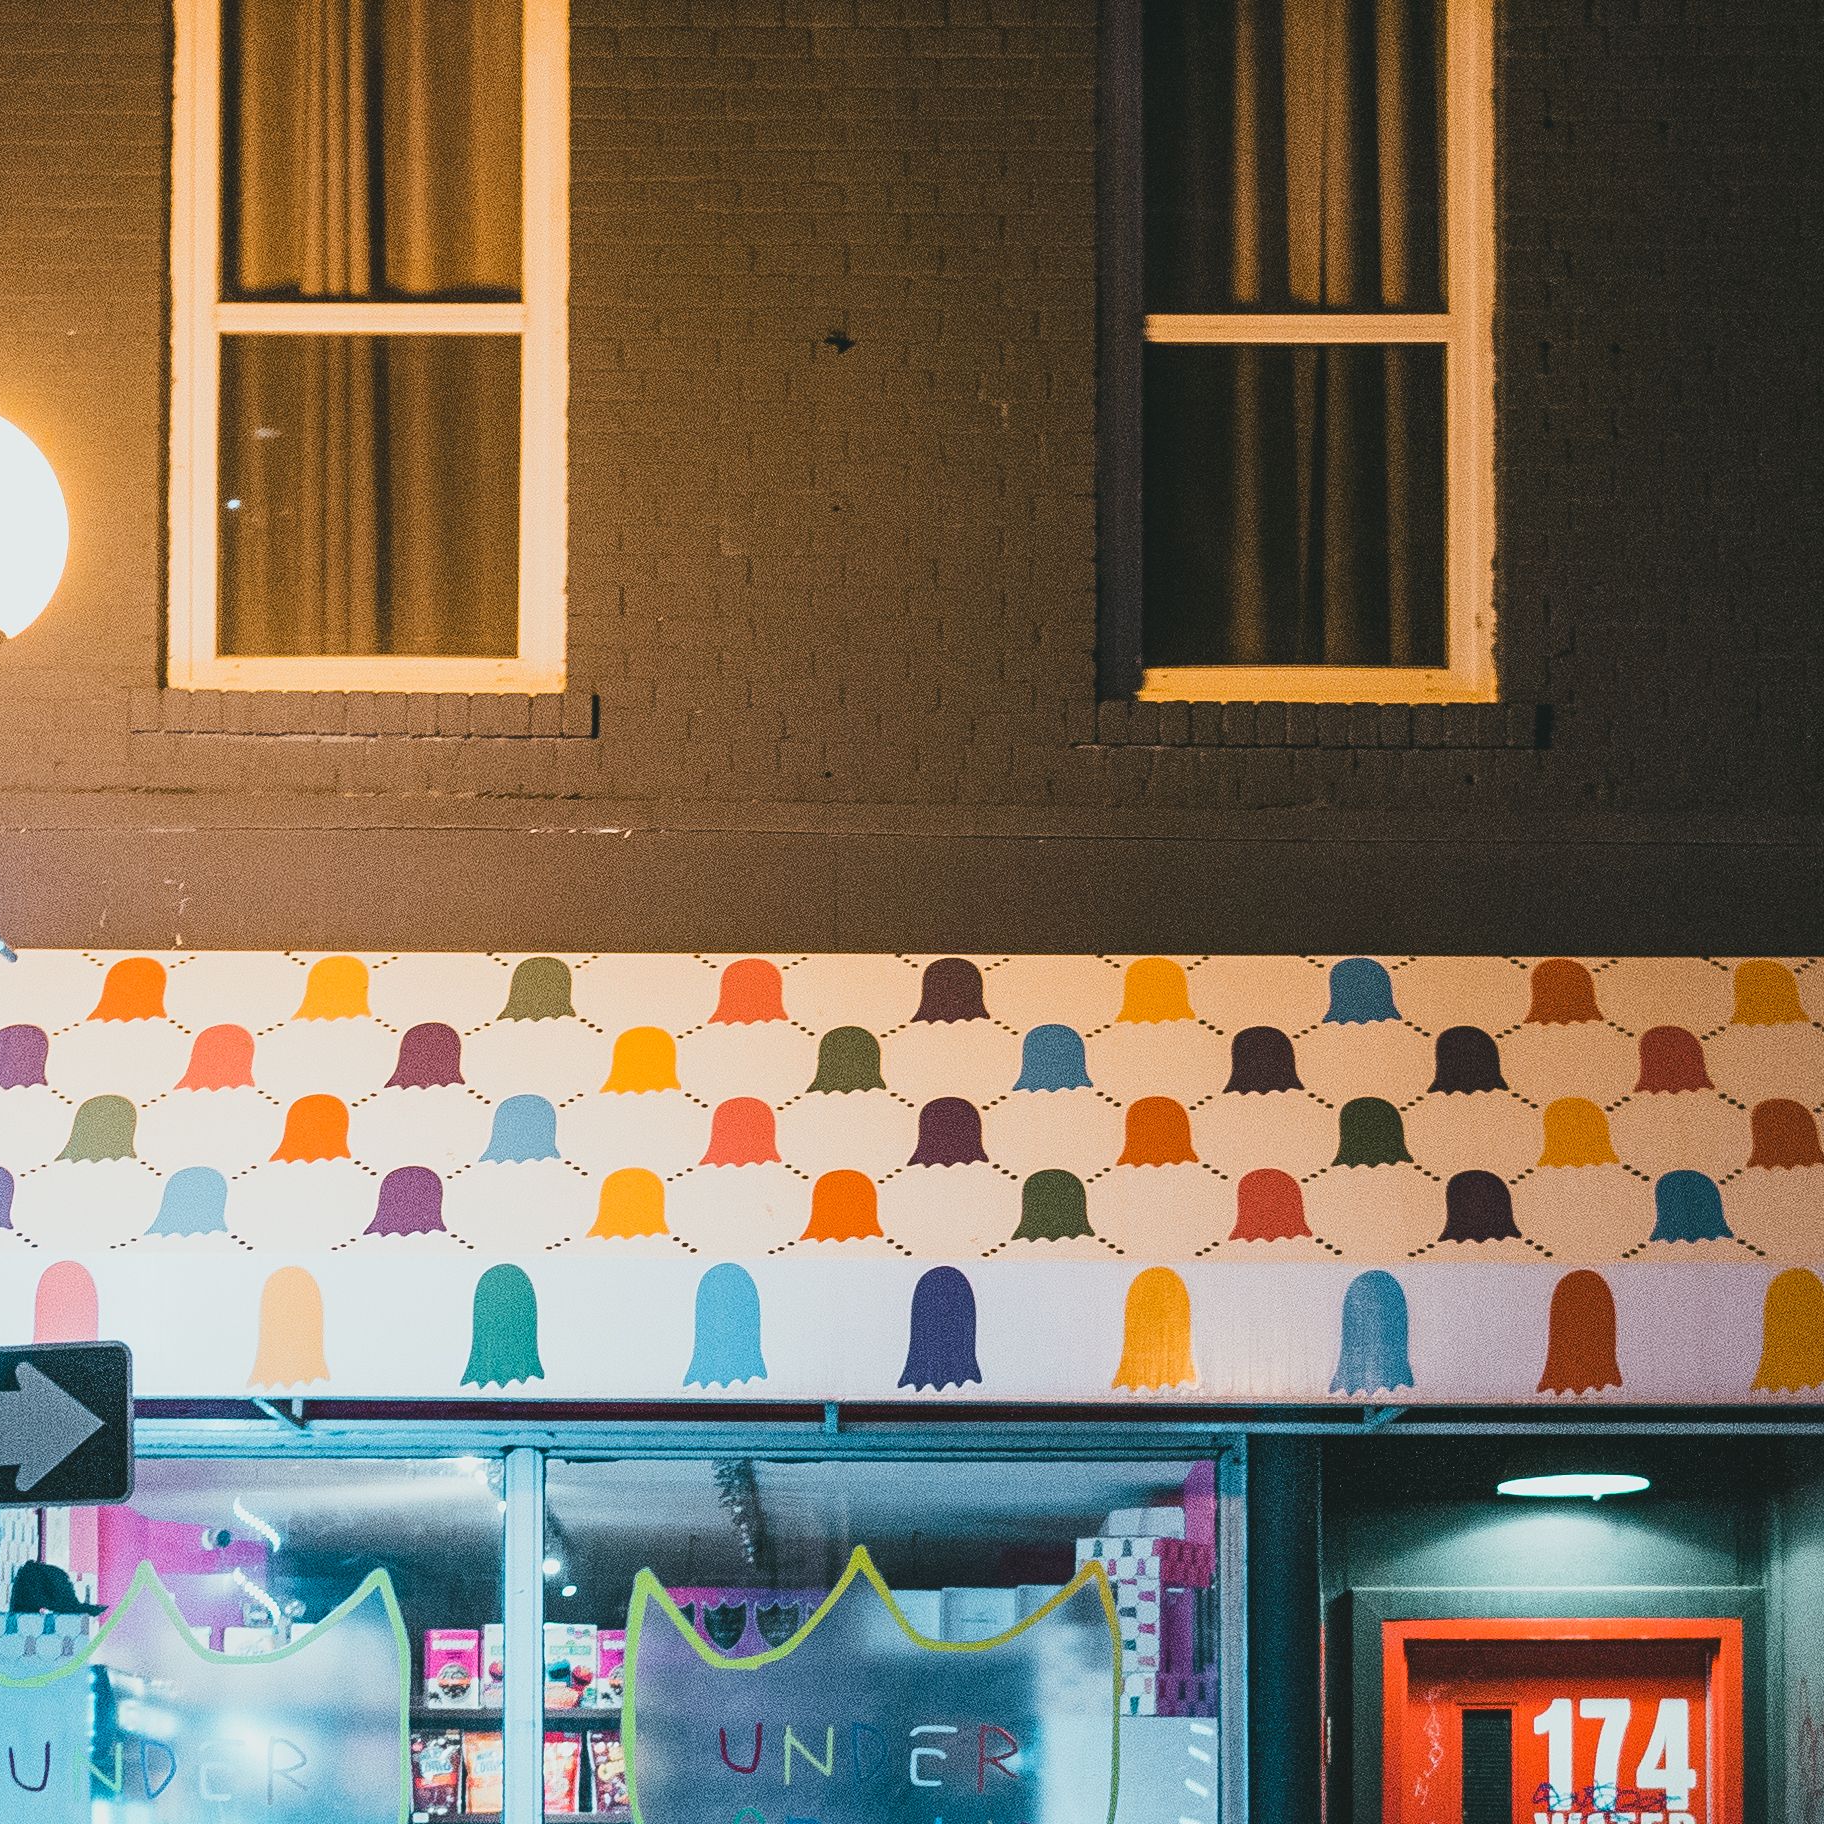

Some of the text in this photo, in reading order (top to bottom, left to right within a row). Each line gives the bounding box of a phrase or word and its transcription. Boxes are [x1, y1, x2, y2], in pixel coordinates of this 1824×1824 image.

[8, 1735, 309, 1805] UNDER
[718, 1722, 1021, 1794] UNDER
[1533, 1697, 1698, 1811] 174
